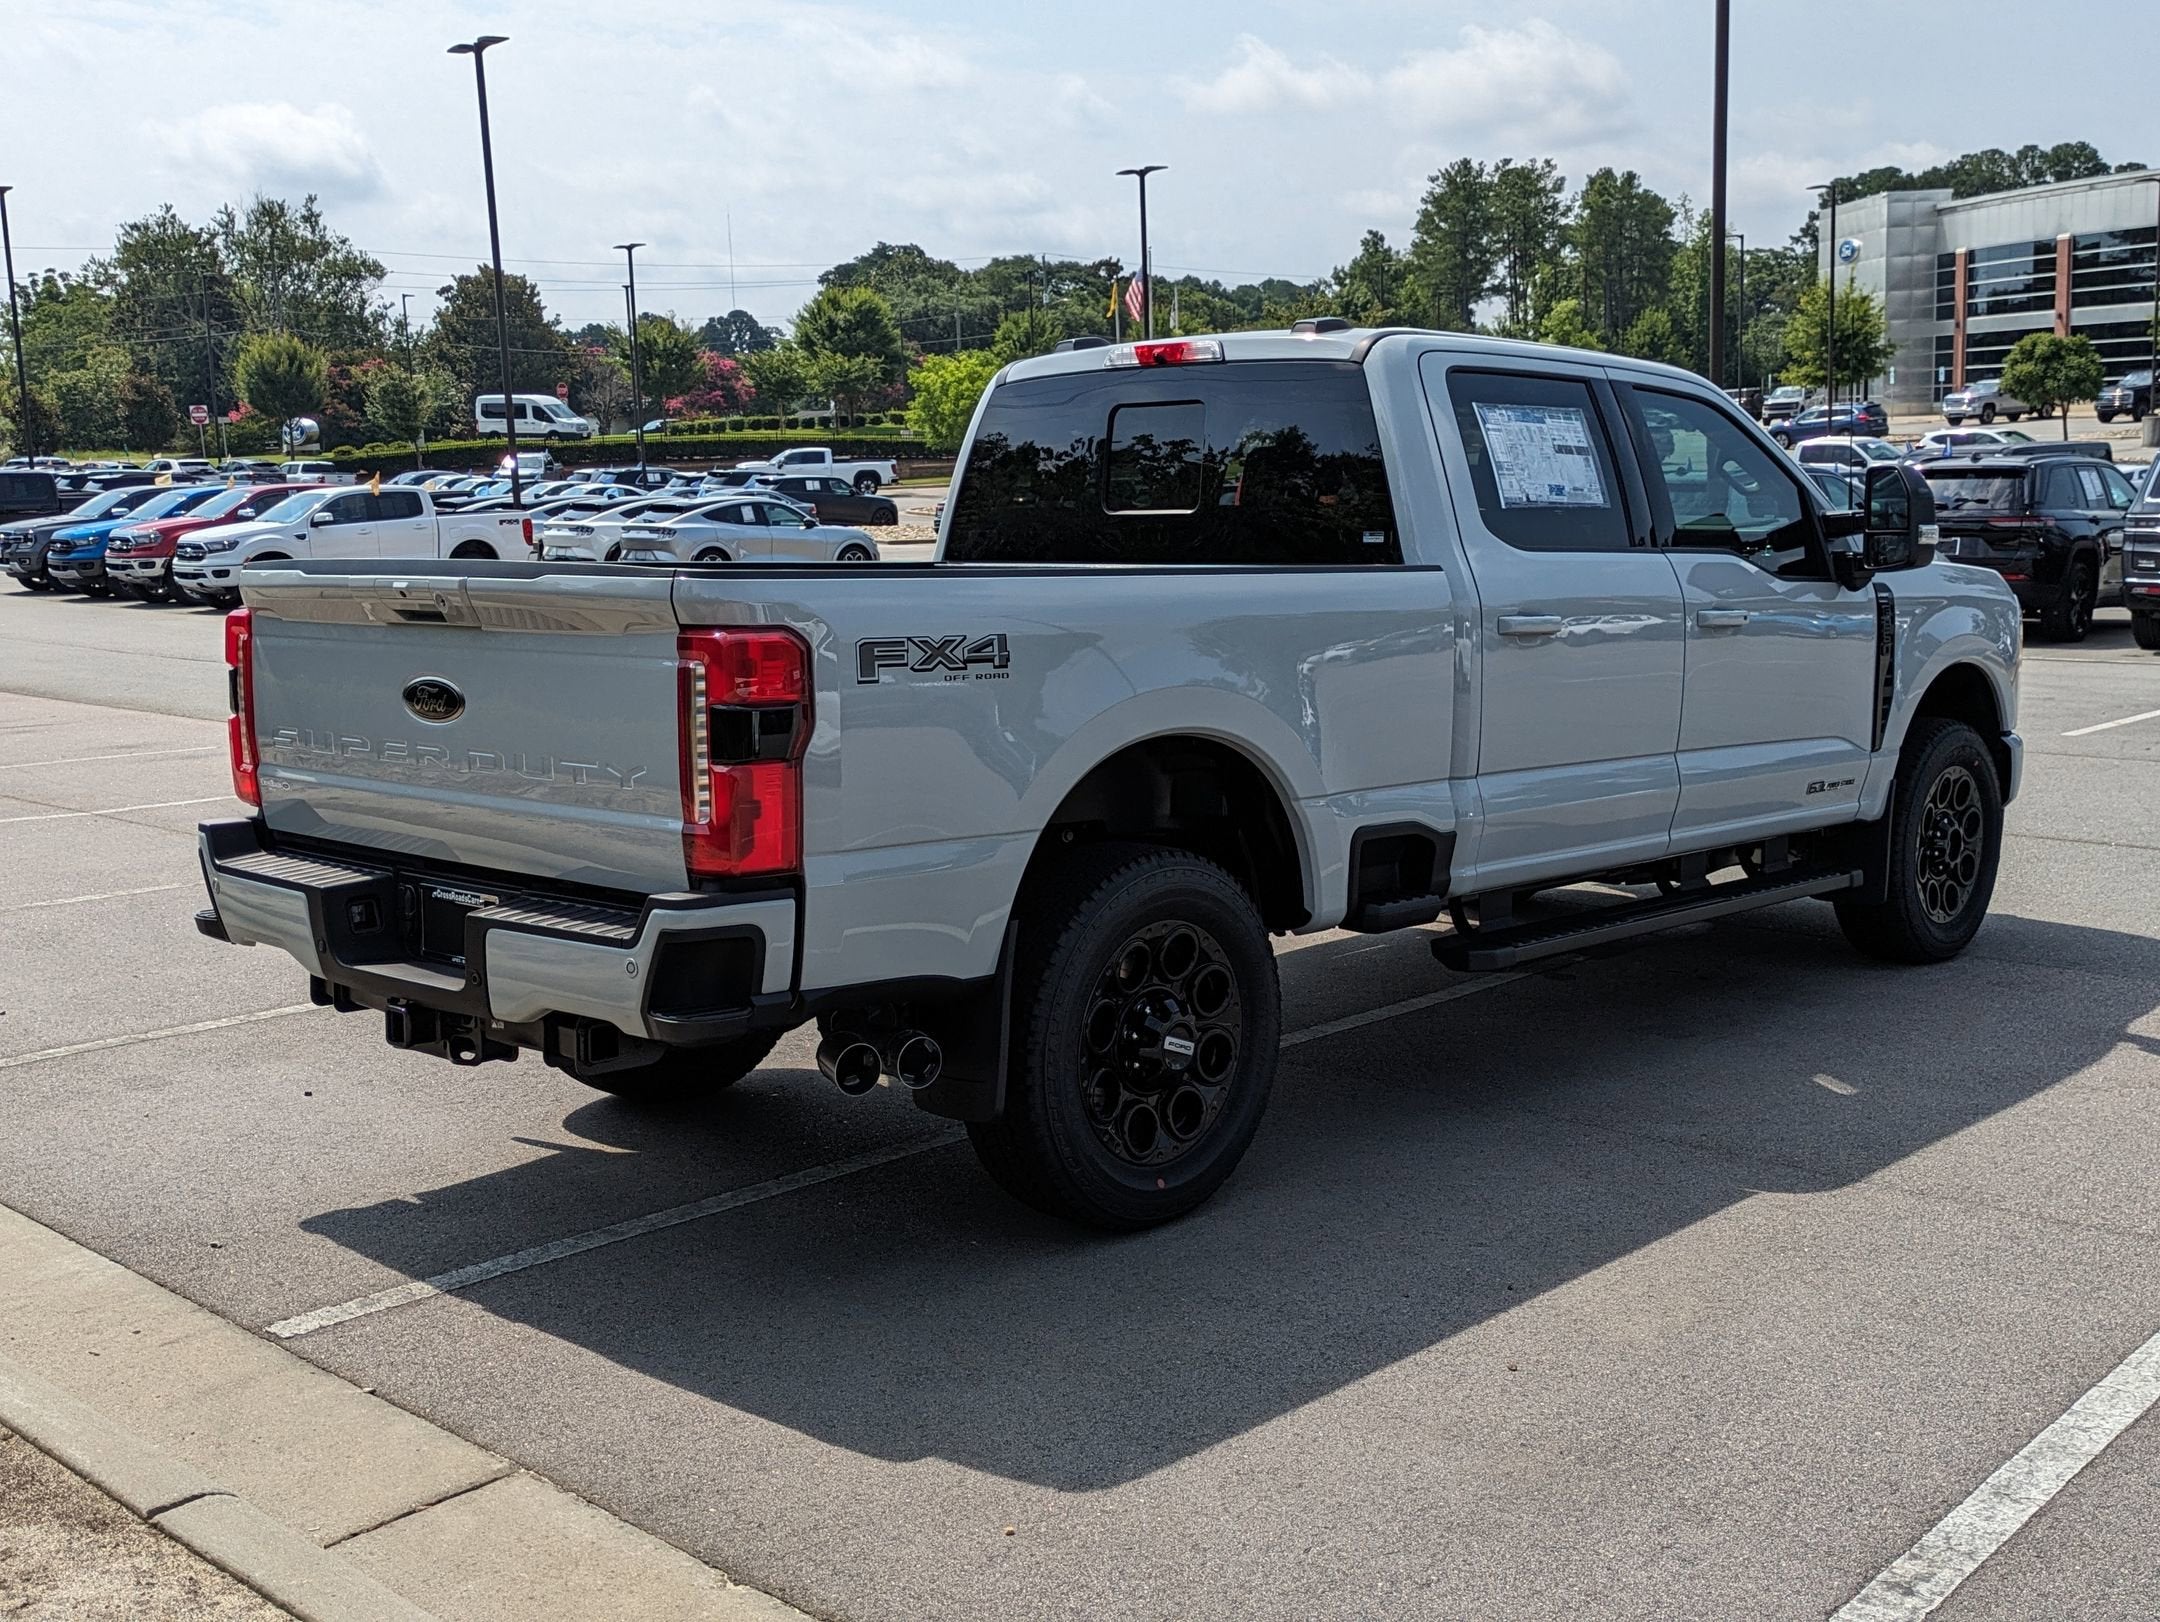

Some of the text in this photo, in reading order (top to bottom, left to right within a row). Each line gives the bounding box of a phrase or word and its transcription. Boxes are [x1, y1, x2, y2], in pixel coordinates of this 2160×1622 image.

[855, 634, 1010, 685] FX4
[944, 672, 1010, 682] OFF ROAD
[413, 685, 448, 713] Ford
[272, 726, 648, 790] SUPER DUTY
[1168, 1041, 1192, 1051] FORD
